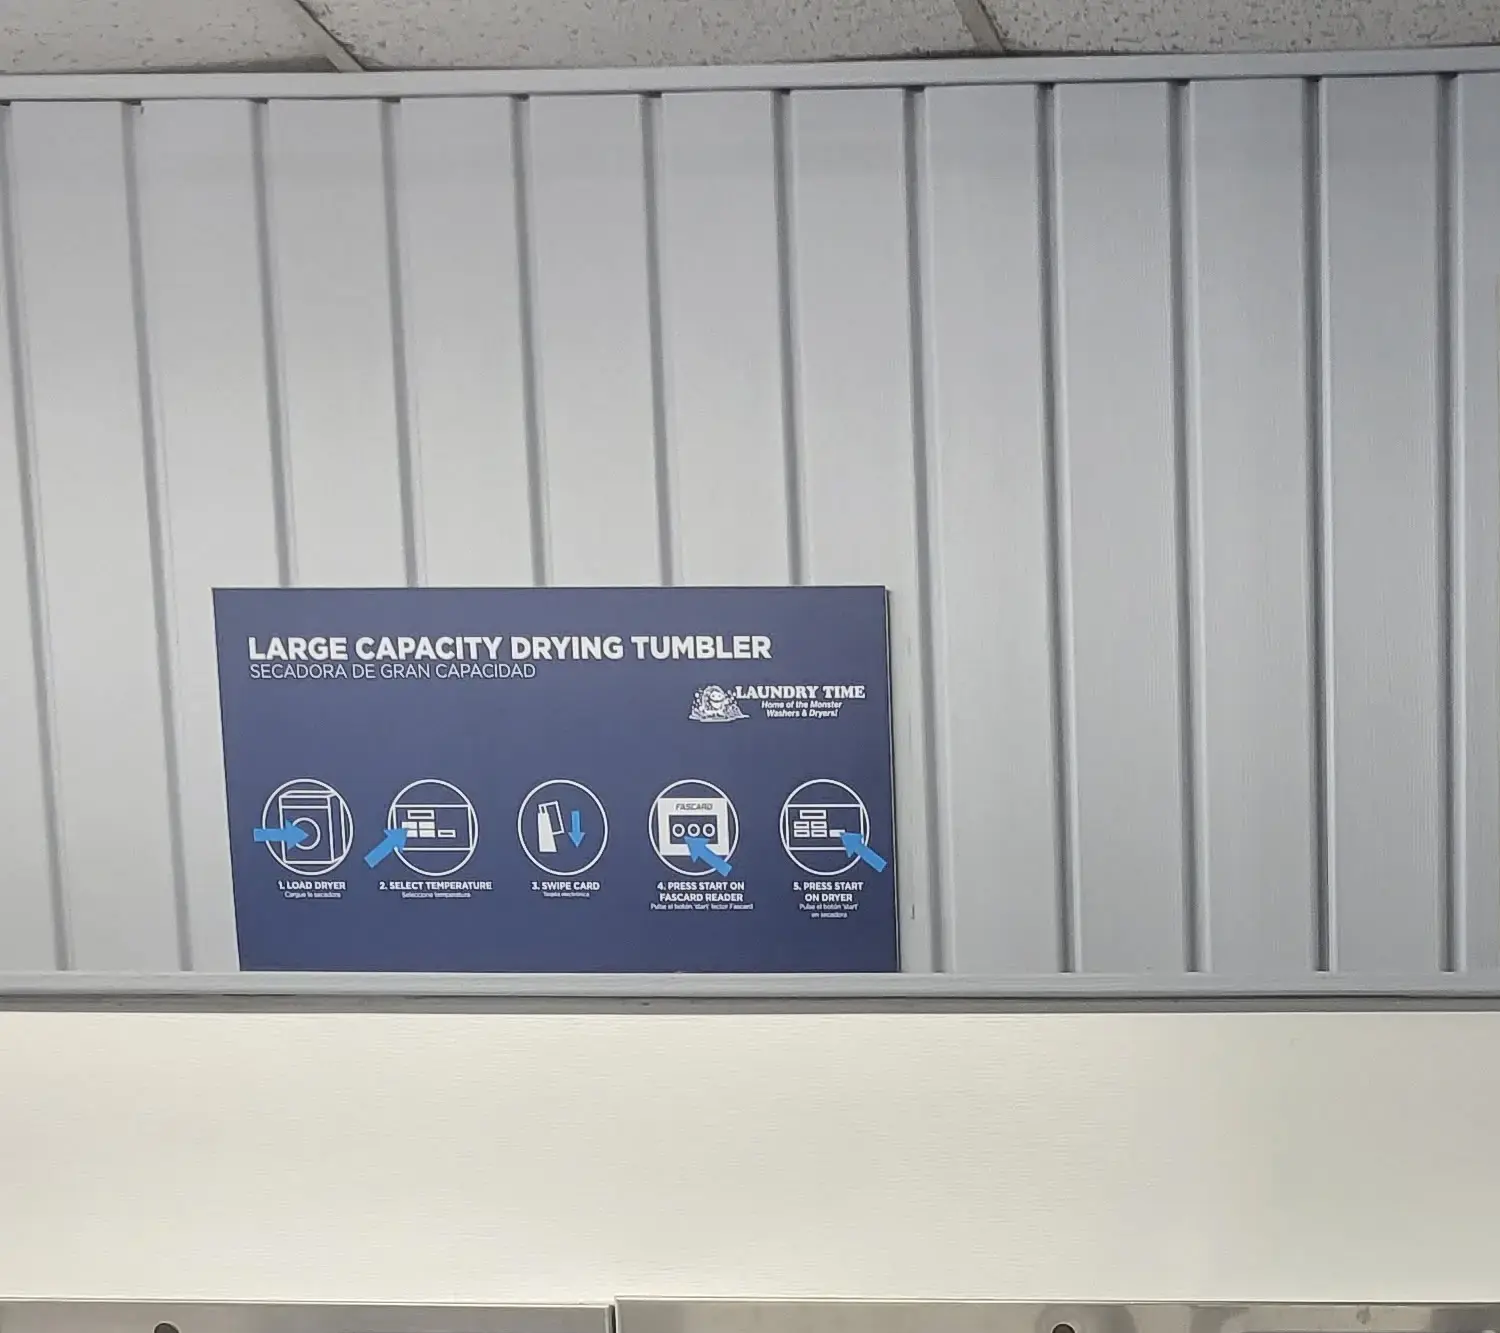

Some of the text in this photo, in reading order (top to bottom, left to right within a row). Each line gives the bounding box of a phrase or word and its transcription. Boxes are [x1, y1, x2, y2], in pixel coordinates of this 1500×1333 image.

[248, 635, 772, 661] LARGE CAPACITY DRYING TUMBLER
[250, 663, 536, 679] SECADORA DE GRAN CAPACIDAD
[735, 685, 866, 699] LAUNDRY TIME
[761, 700, 842, 709] Home of the Monster
[766, 709, 800, 718] Washers
[675, 803, 714, 811] FASCARD
[286, 881, 313, 890] LOAD
[314, 881, 346, 890] DRYER
[379, 881, 493, 890] 2. SELECT TEMPERATURE
[531, 881, 600, 891] 3. SWIPE CARD
[656, 881, 745, 891] 4. PRESS START ON
[792, 881, 864, 891] 5. PRESS START
[659, 893, 744, 902] FASCARD READER
[804, 893, 853, 902] ON DRYER
